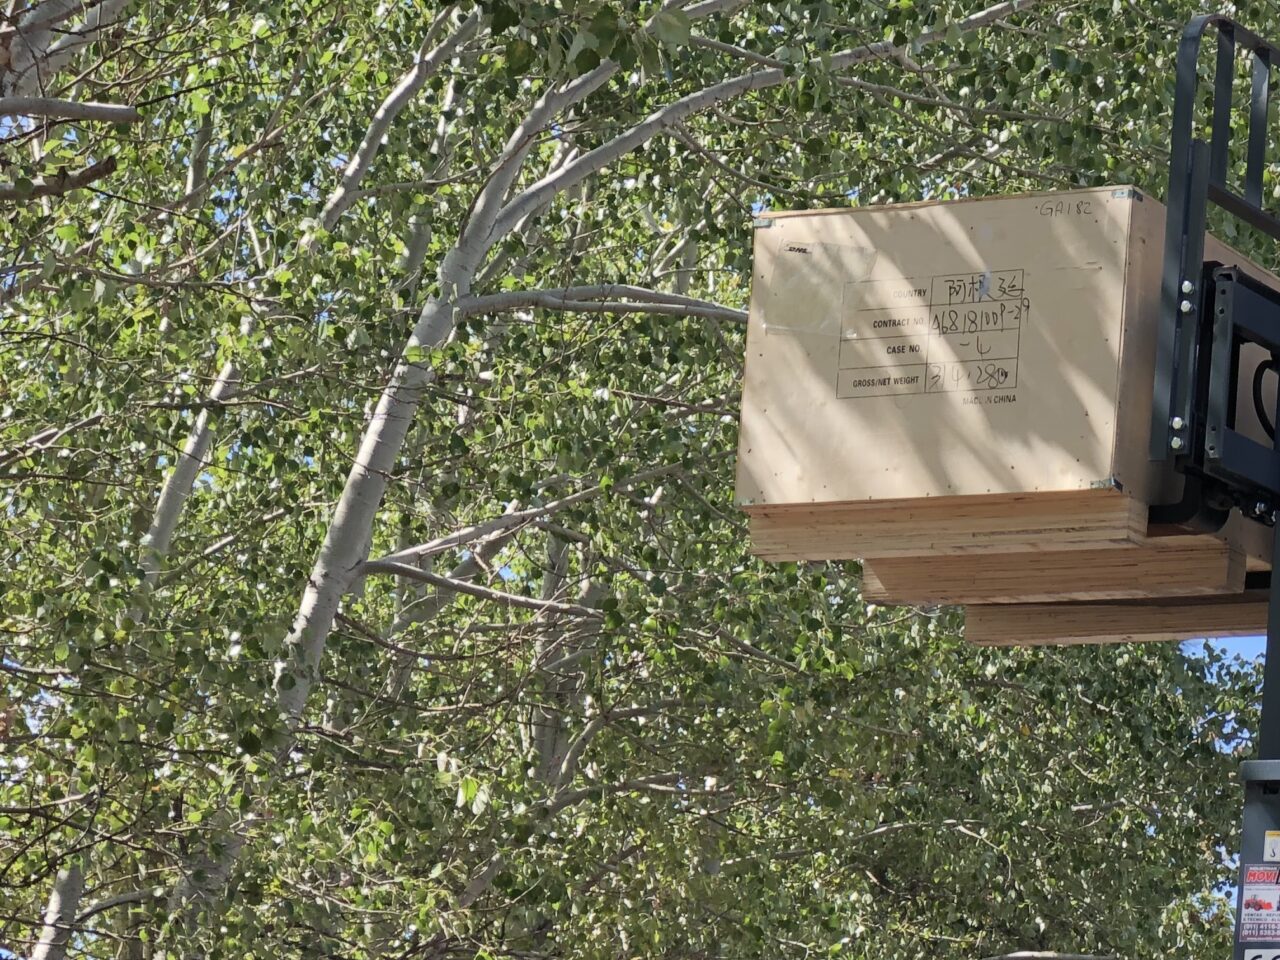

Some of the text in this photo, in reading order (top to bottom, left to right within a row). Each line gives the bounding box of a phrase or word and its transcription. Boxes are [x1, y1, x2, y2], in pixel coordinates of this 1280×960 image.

[893, 288, 927, 298] COUNTRY
[873, 317, 910, 328] CONTRACT
[886, 345, 906, 354] CASE
[852, 376, 919, 388] GROSS/NET WEIGHT
[994, 394, 1017, 404] CHINA
